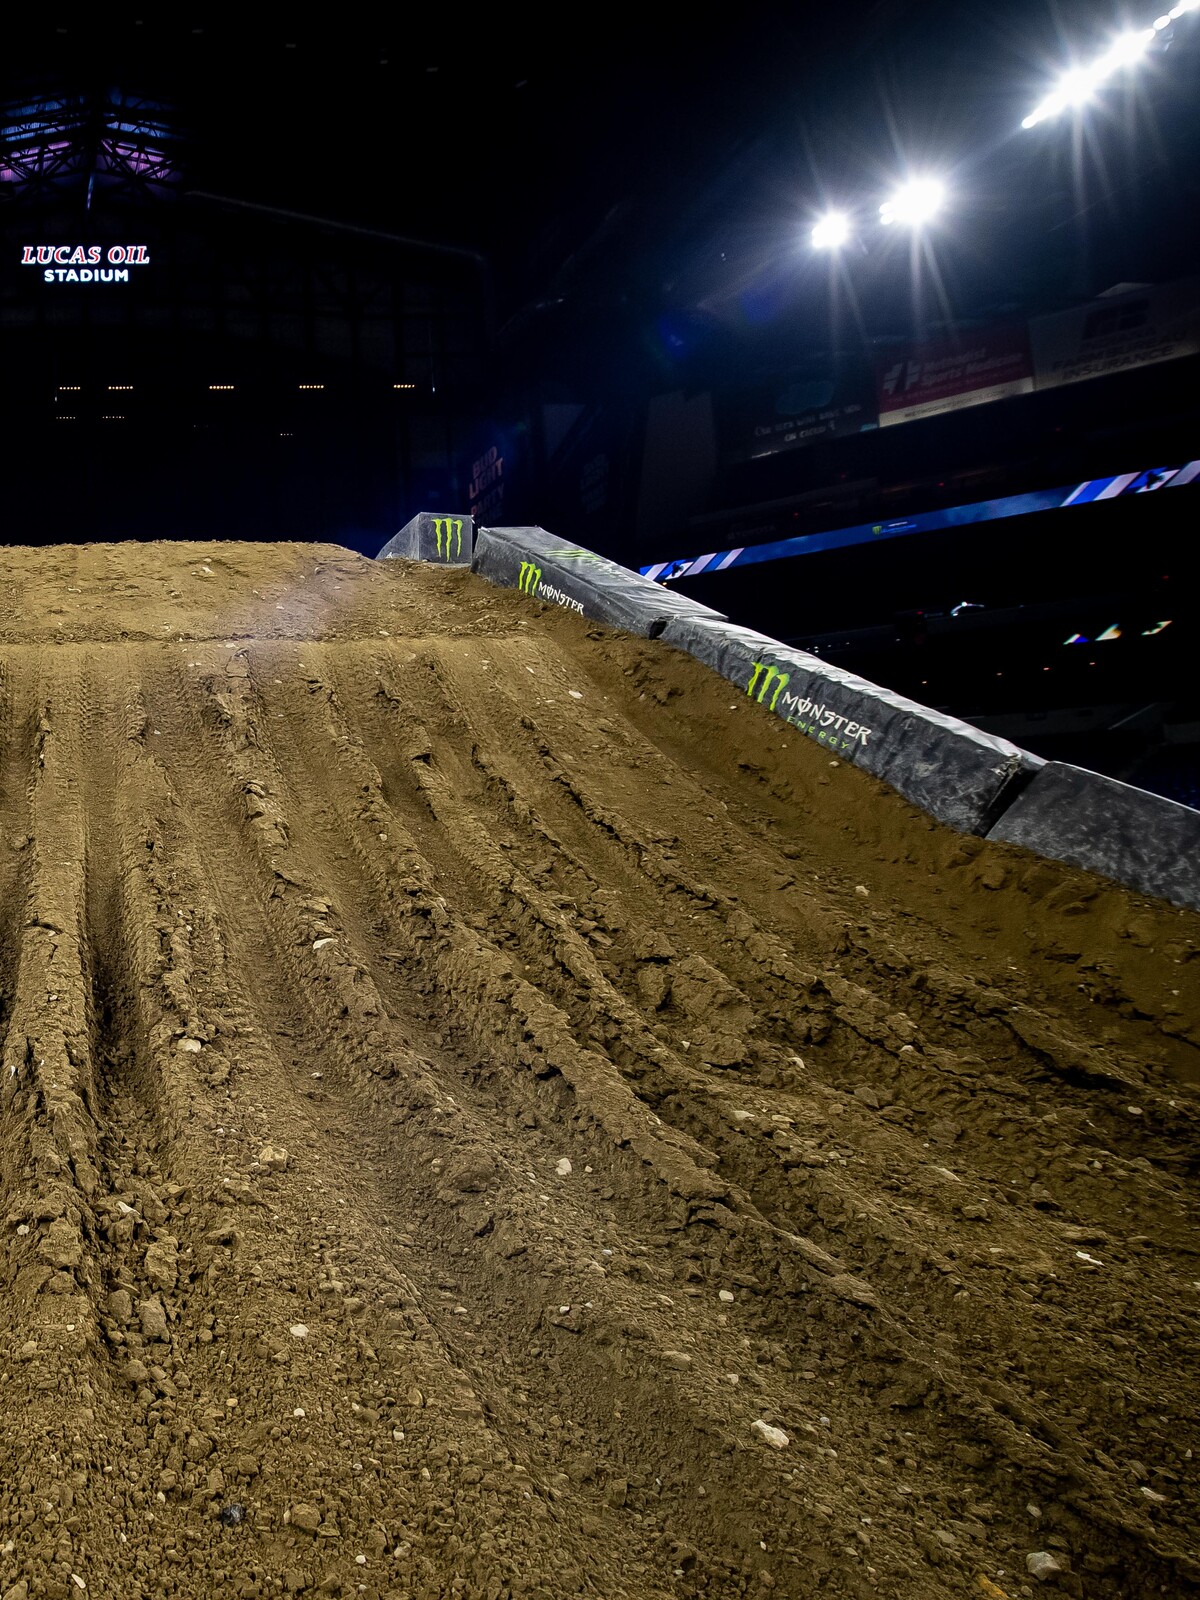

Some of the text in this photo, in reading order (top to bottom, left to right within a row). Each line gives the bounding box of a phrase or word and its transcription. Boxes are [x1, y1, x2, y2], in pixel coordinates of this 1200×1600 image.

[21, 245, 150, 264] LUCAS OIL
[44, 269, 129, 282] STADIUM
[538, 581, 585, 615] MONSTER
[782, 691, 872, 746] MONSTER
[786, 715, 850, 749] ENERGY
